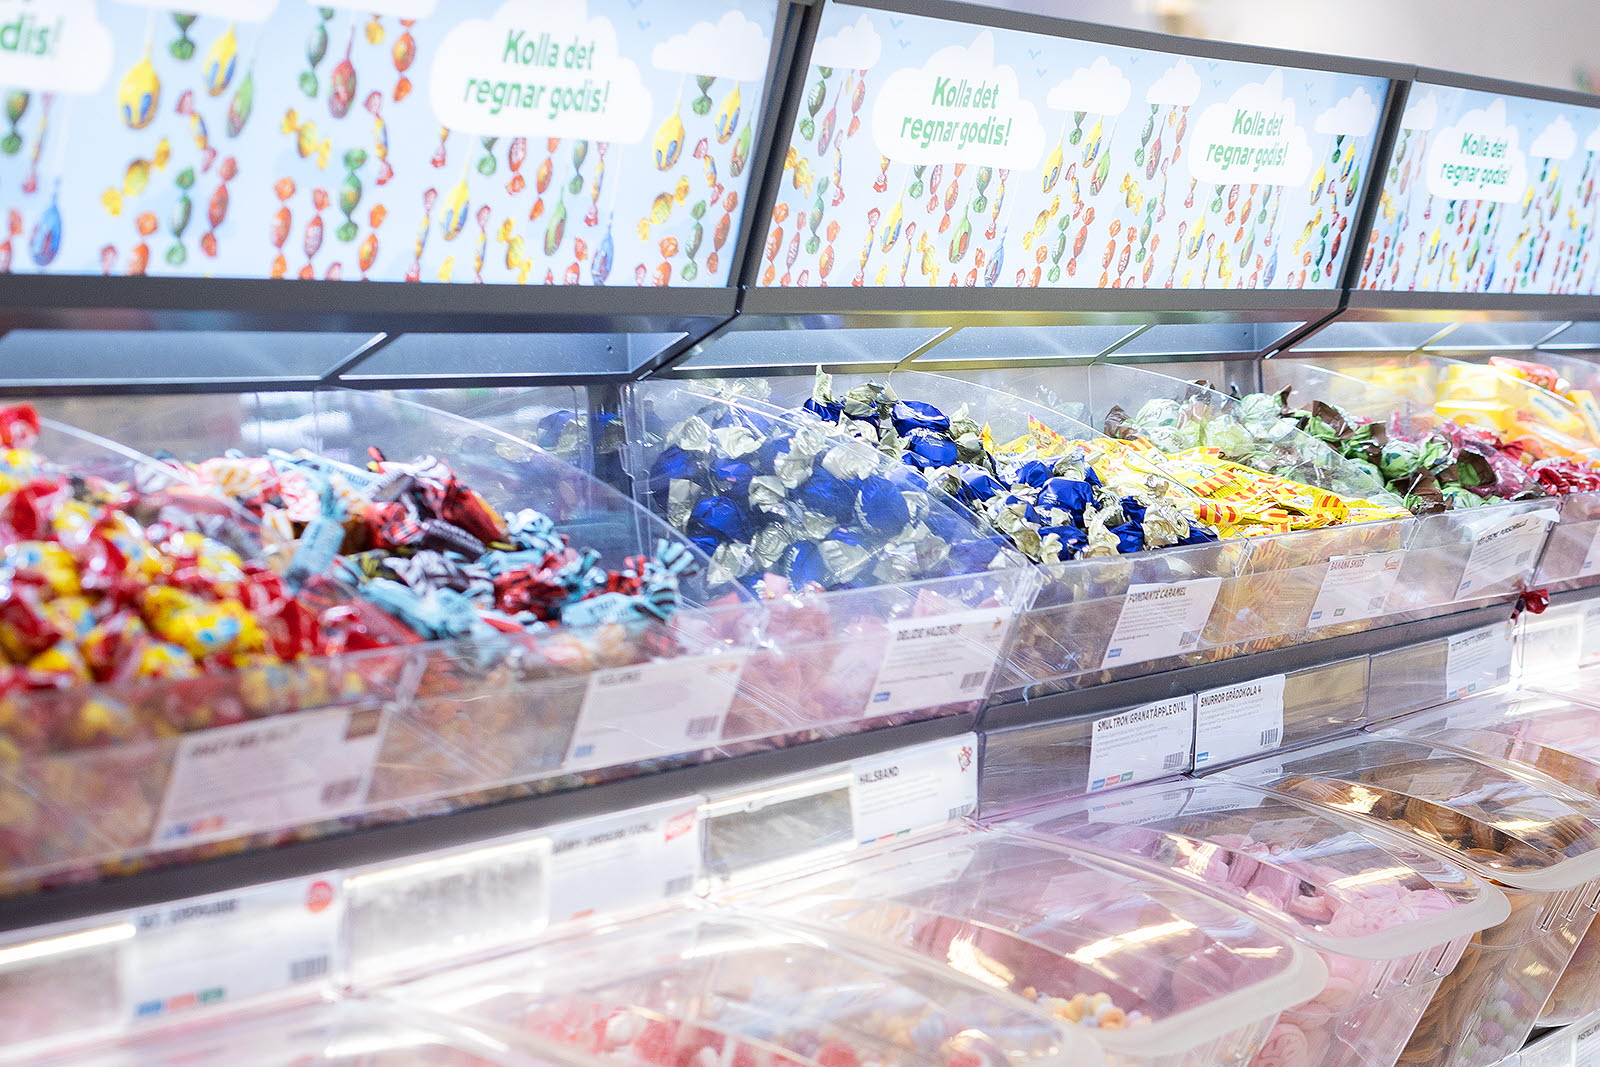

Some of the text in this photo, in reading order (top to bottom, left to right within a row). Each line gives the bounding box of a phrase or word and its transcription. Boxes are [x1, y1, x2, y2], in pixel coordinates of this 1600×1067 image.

[503, 29, 595, 70] Kolla det
[464, 77, 610, 119] regnar godis!
[932, 76, 999, 109] Kolla det
[900, 116, 1012, 150] regnar godis!
[1231, 108, 1284, 136] Kolla det
[1206, 142, 1289, 173] regnar godis!
[1460, 132, 1508, 158] Kolla det
[1440, 163, 1481, 187] regnar
[1200, 691, 1226, 708] SNURROR
